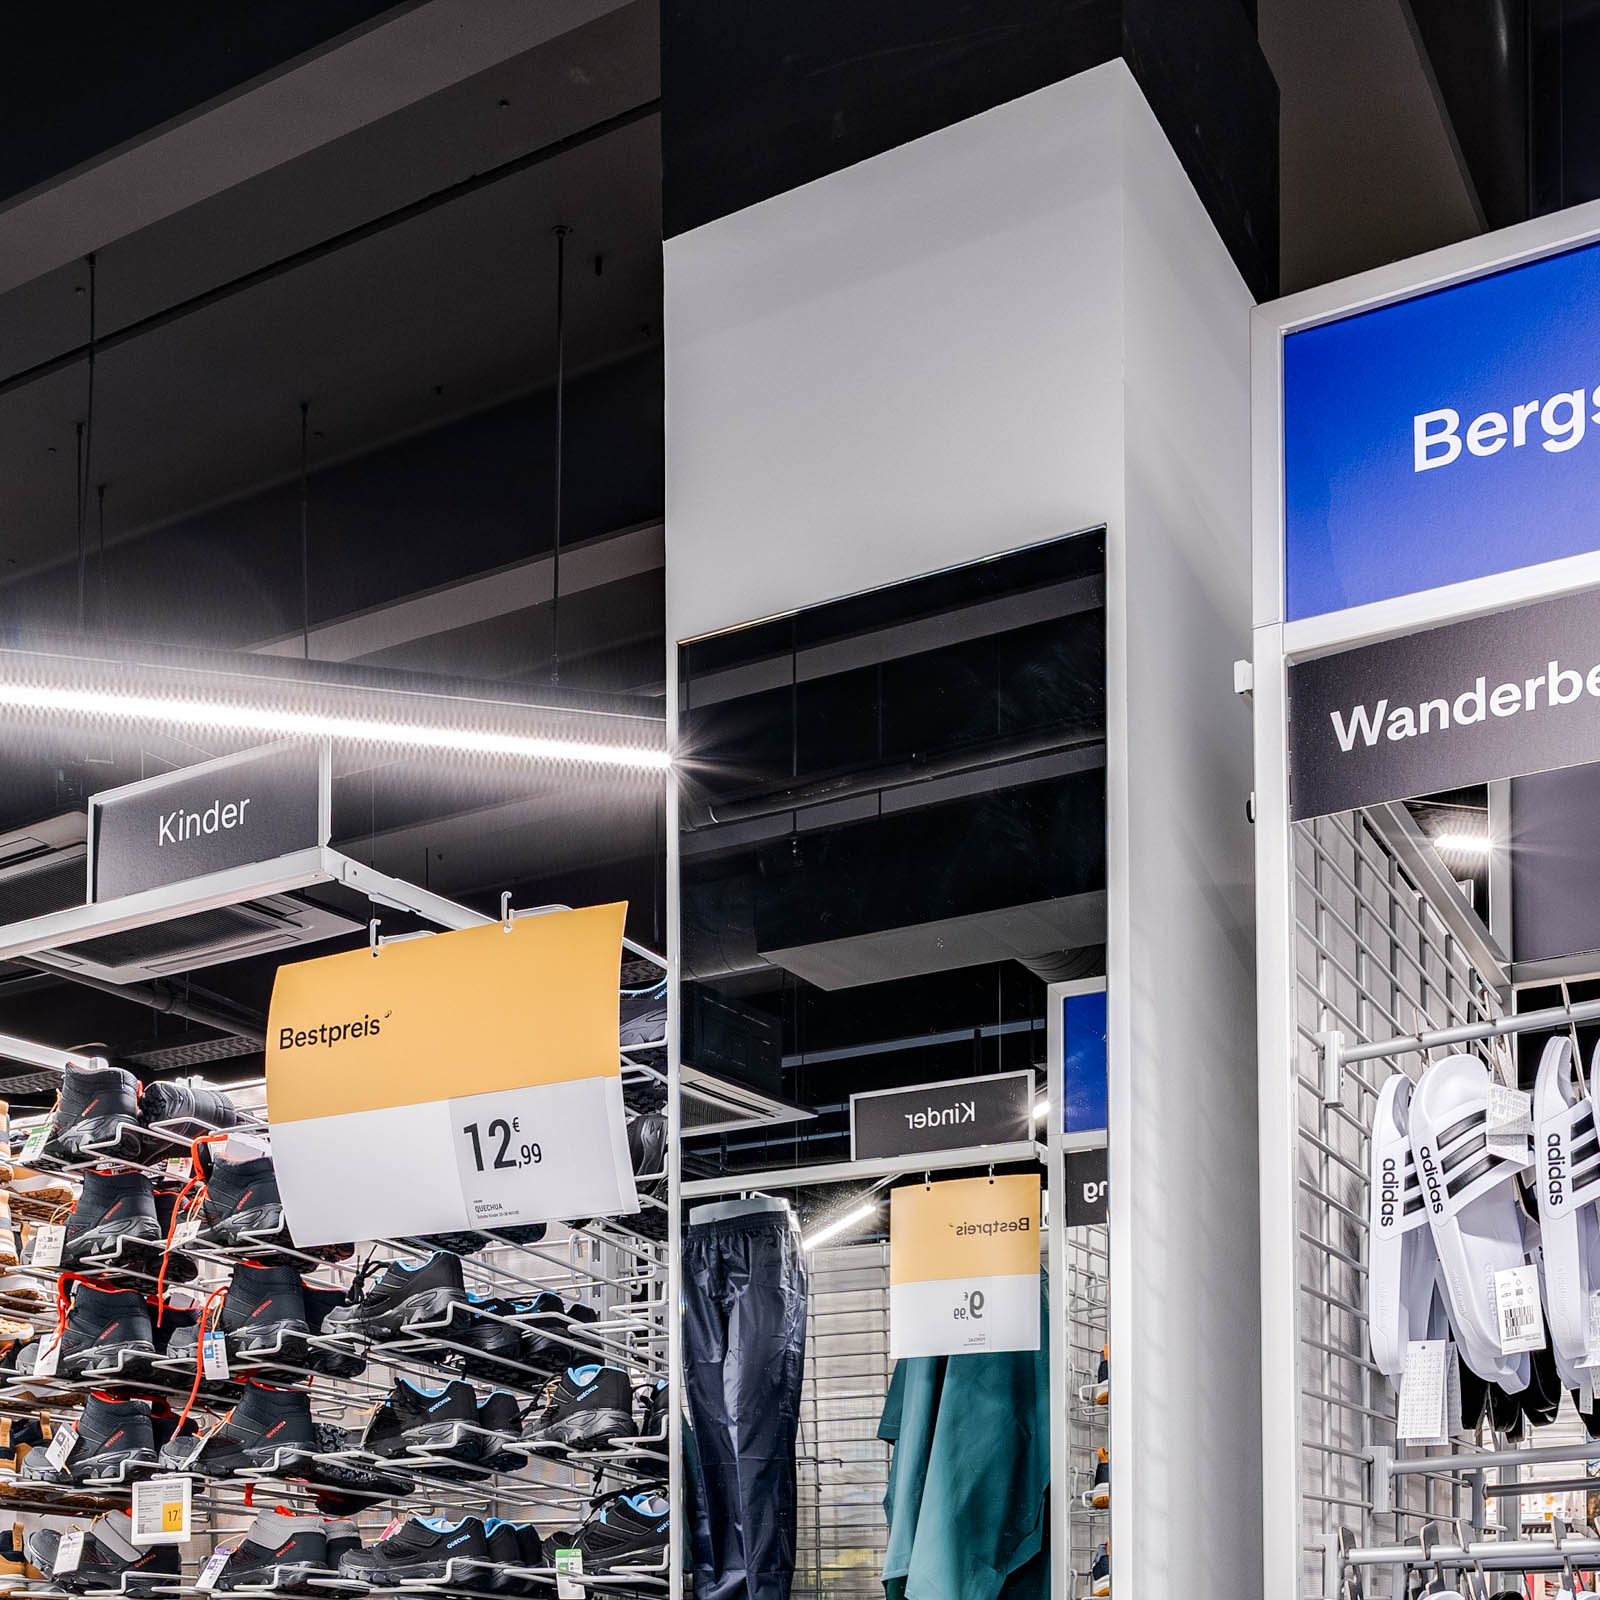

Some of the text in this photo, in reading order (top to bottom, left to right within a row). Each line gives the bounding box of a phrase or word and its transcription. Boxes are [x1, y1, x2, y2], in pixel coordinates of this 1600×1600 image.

[157, 794, 252, 848] Kinder
[278, 1012, 382, 1051] Bestpreis
[1420, 1145, 1445, 1215] adidas
[1546, 1132, 1567, 1207] adidas
[474, 1203, 503, 1213] QUECHUA
[1381, 1157, 1400, 1228] adidas
[428, 1396, 452, 1413] QUECHUA
[577, 1384, 600, 1401] QUECHUA
[447, 1533, 471, 1549] QUECHUA
